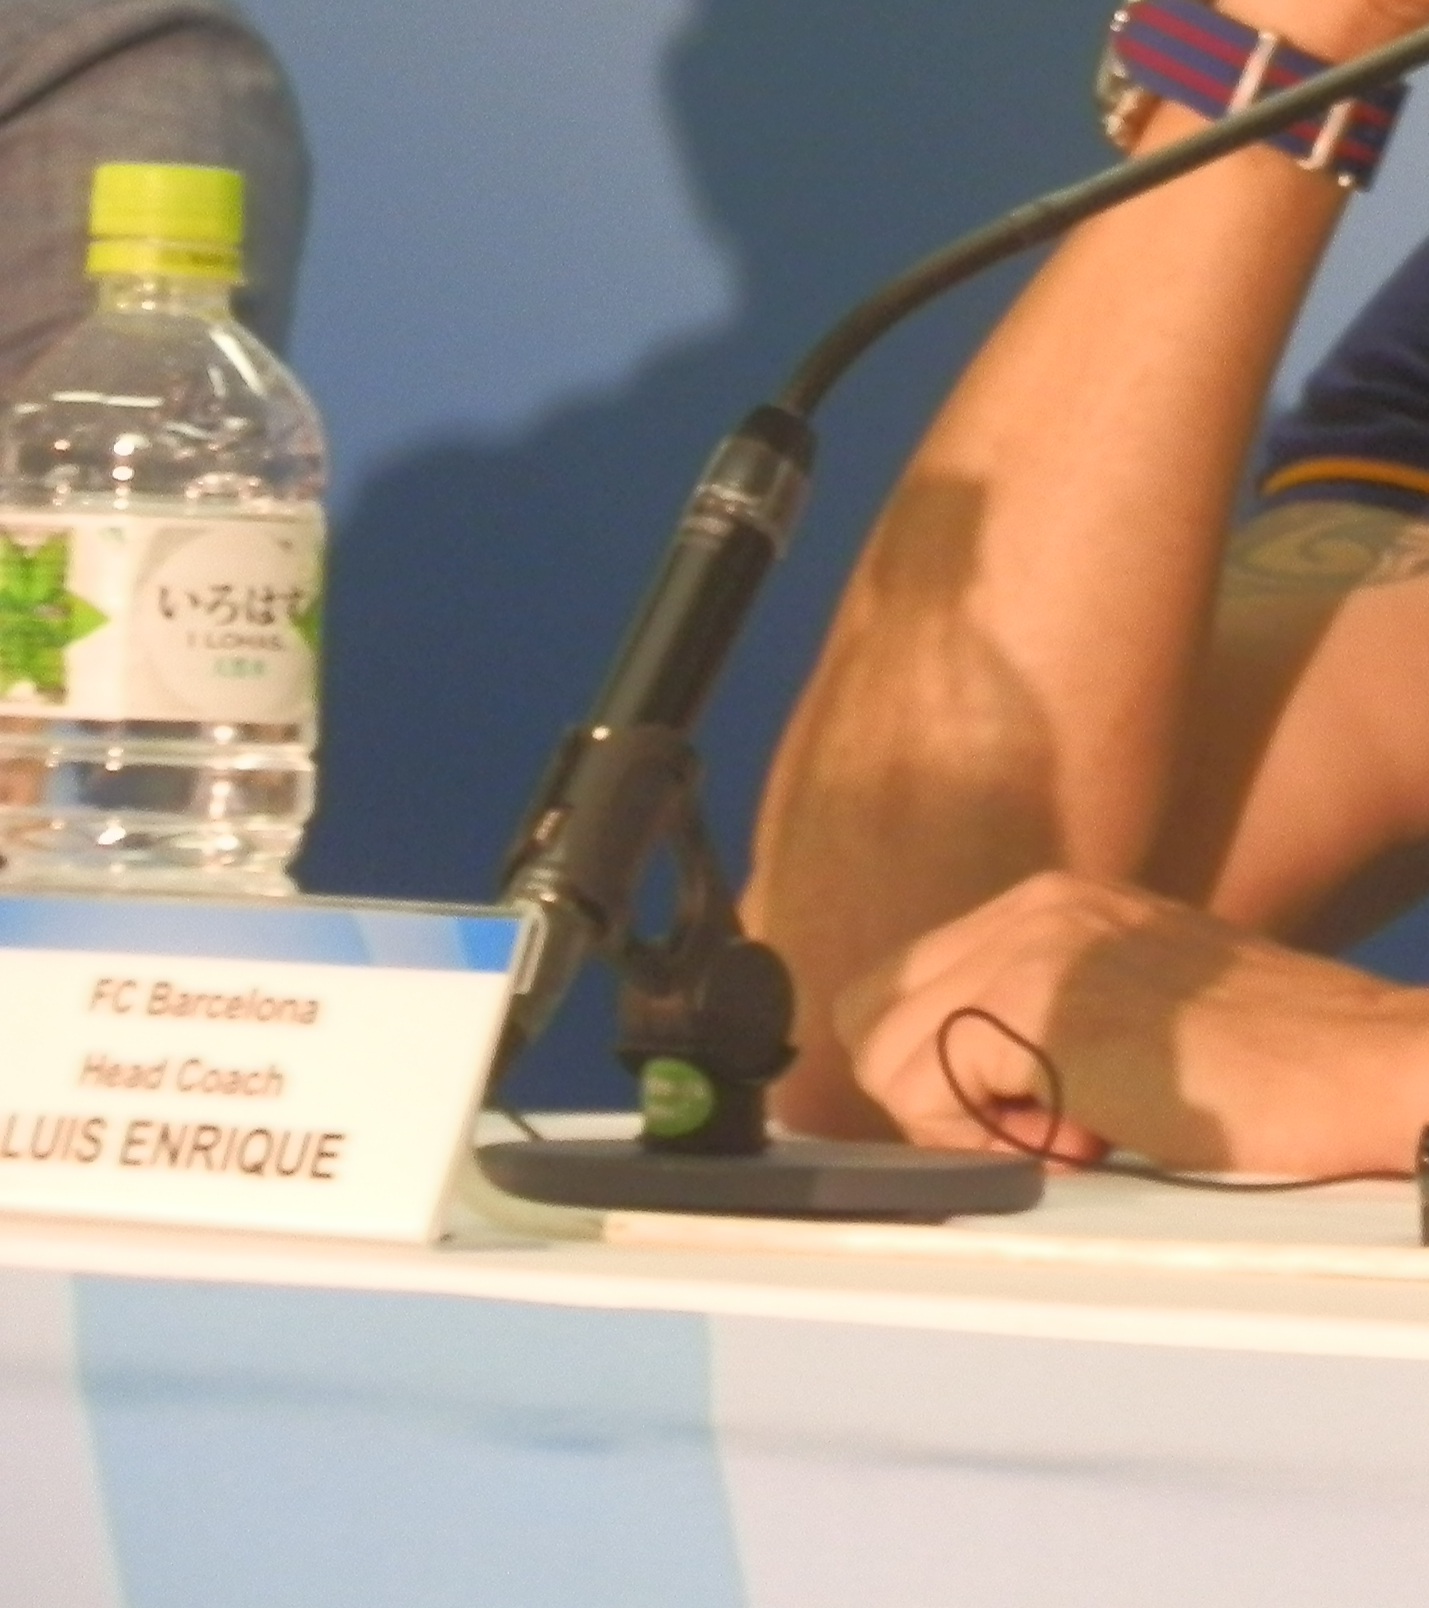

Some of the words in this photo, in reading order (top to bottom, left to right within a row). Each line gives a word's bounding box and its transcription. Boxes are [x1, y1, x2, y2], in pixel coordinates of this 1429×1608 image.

[90, 978, 136, 1014] FC
[147, 980, 320, 1026] Barcelona
[79, 1055, 169, 1091] Head
[176, 1057, 285, 1097] Coach
[0, 1112, 107, 1163] LUIS
[118, 1119, 346, 1180] ENRIQUE
